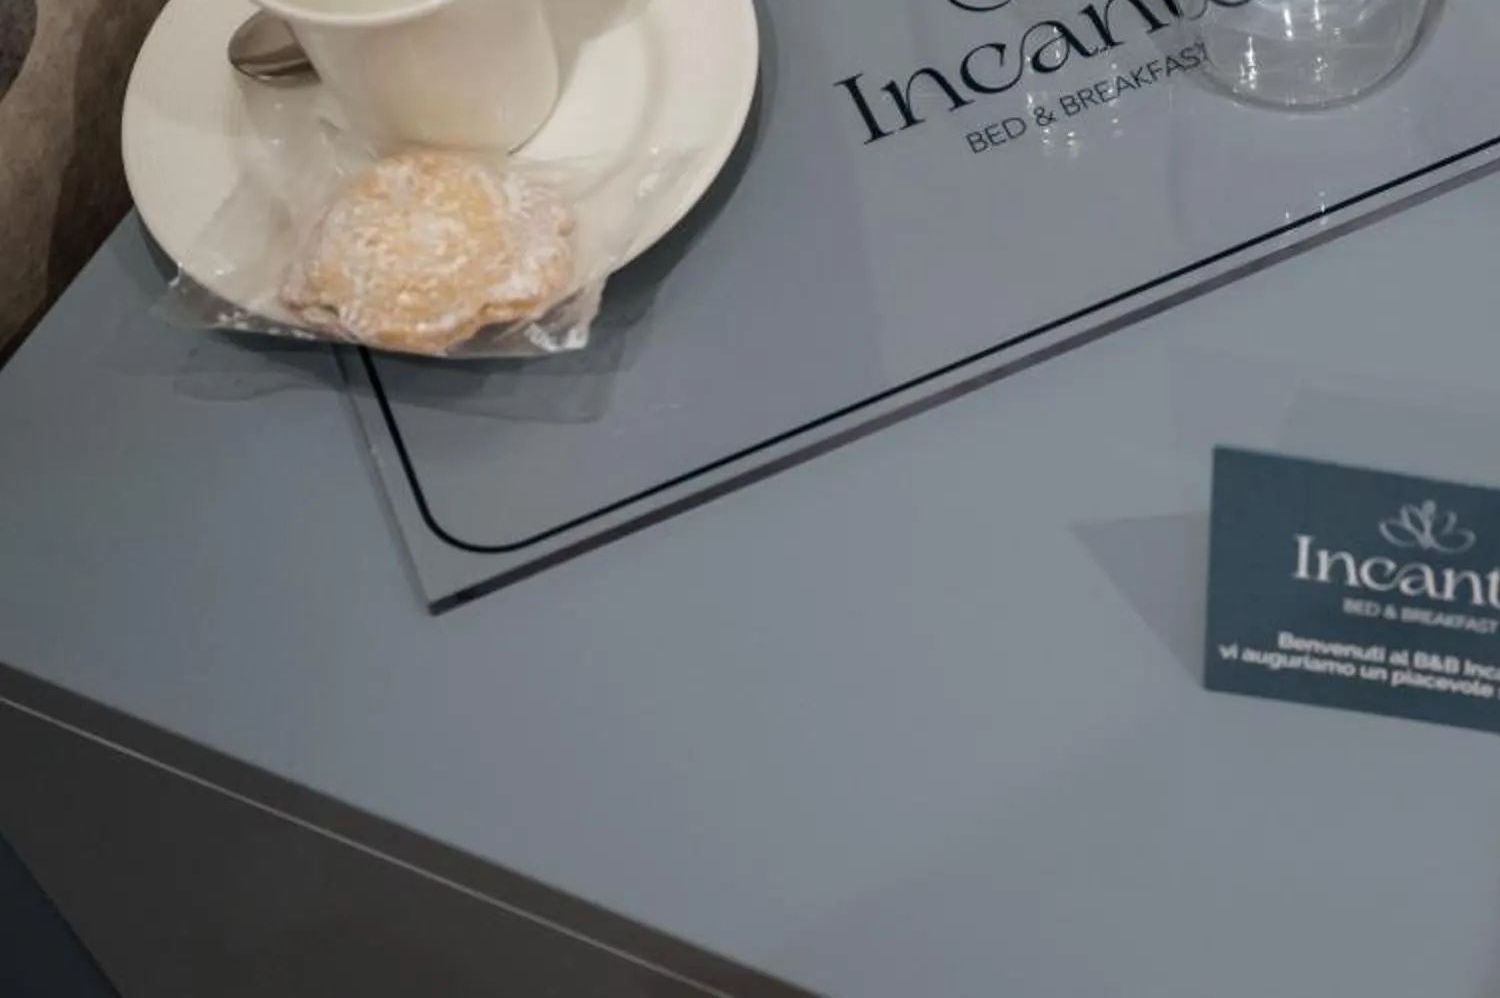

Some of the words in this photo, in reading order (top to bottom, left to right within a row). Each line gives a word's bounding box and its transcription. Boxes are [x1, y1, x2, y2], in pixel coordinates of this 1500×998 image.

[966, 117, 1027, 154] BED
[1033, 106, 1056, 127] &
[1059, 41, 1210, 117] BREAKFAST
[1343, 598, 1382, 618] BED
[1401, 607, 1500, 634] BREAKFAST
[1218, 643, 1240, 660] vi
[1241, 647, 1356, 677] auguriamo
[1359, 664, 1388, 681] un
[1391, 667, 1495, 699] piacevole
[1277, 630, 1387, 663] Benvenuti
[1389, 650, 1409, 666] al
[1412, 651, 1461, 675] B&B
